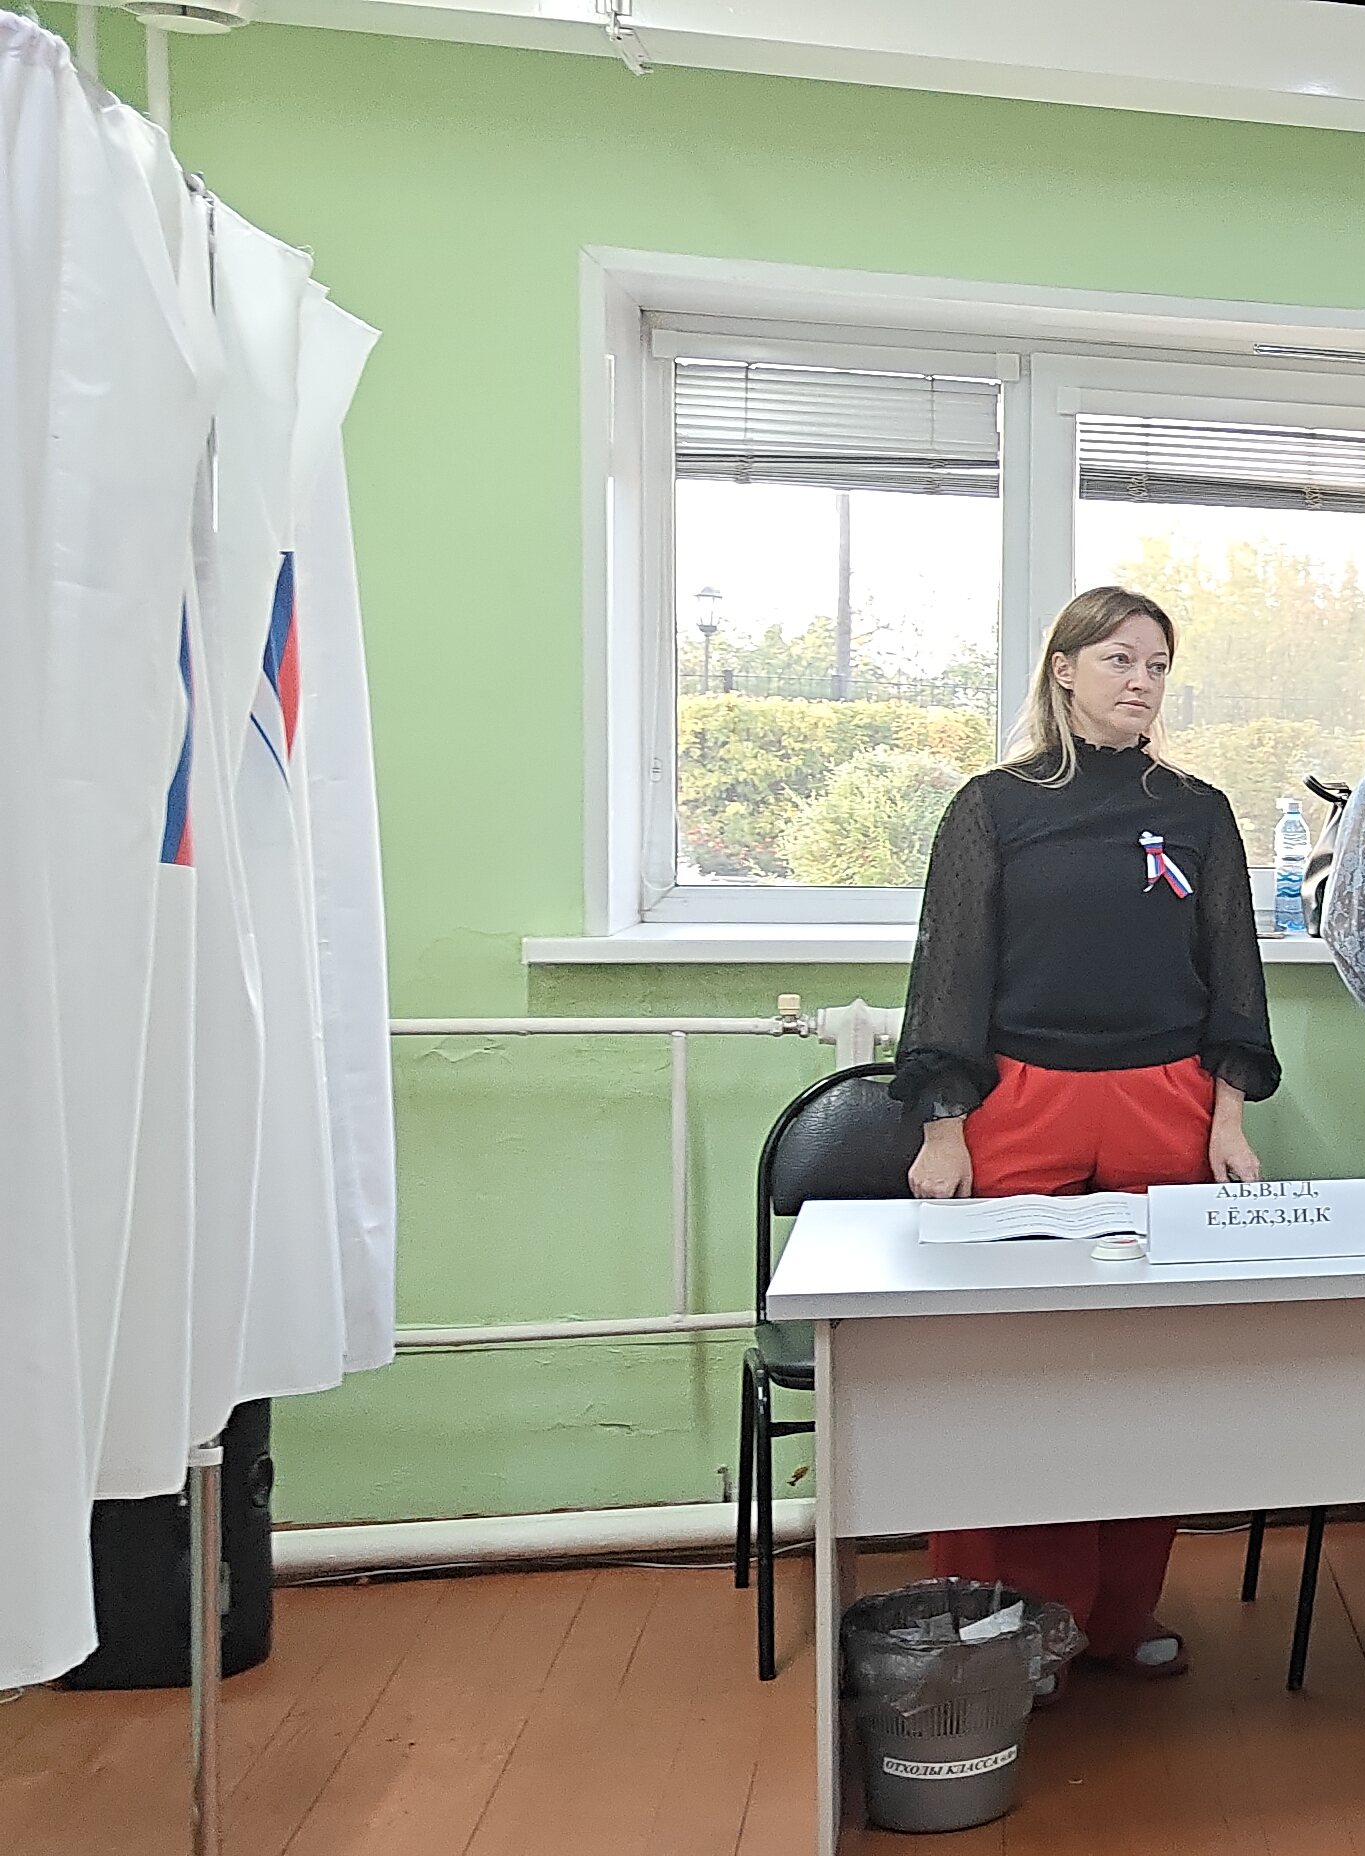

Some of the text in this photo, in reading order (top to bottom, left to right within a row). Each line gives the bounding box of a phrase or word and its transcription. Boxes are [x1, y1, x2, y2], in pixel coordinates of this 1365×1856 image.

[1206, 1206, 1331, 1229] Е,Ё,Ж,З,И,К
[885, 1756, 998, 1777] ОТХОДЫ КЛАССА
